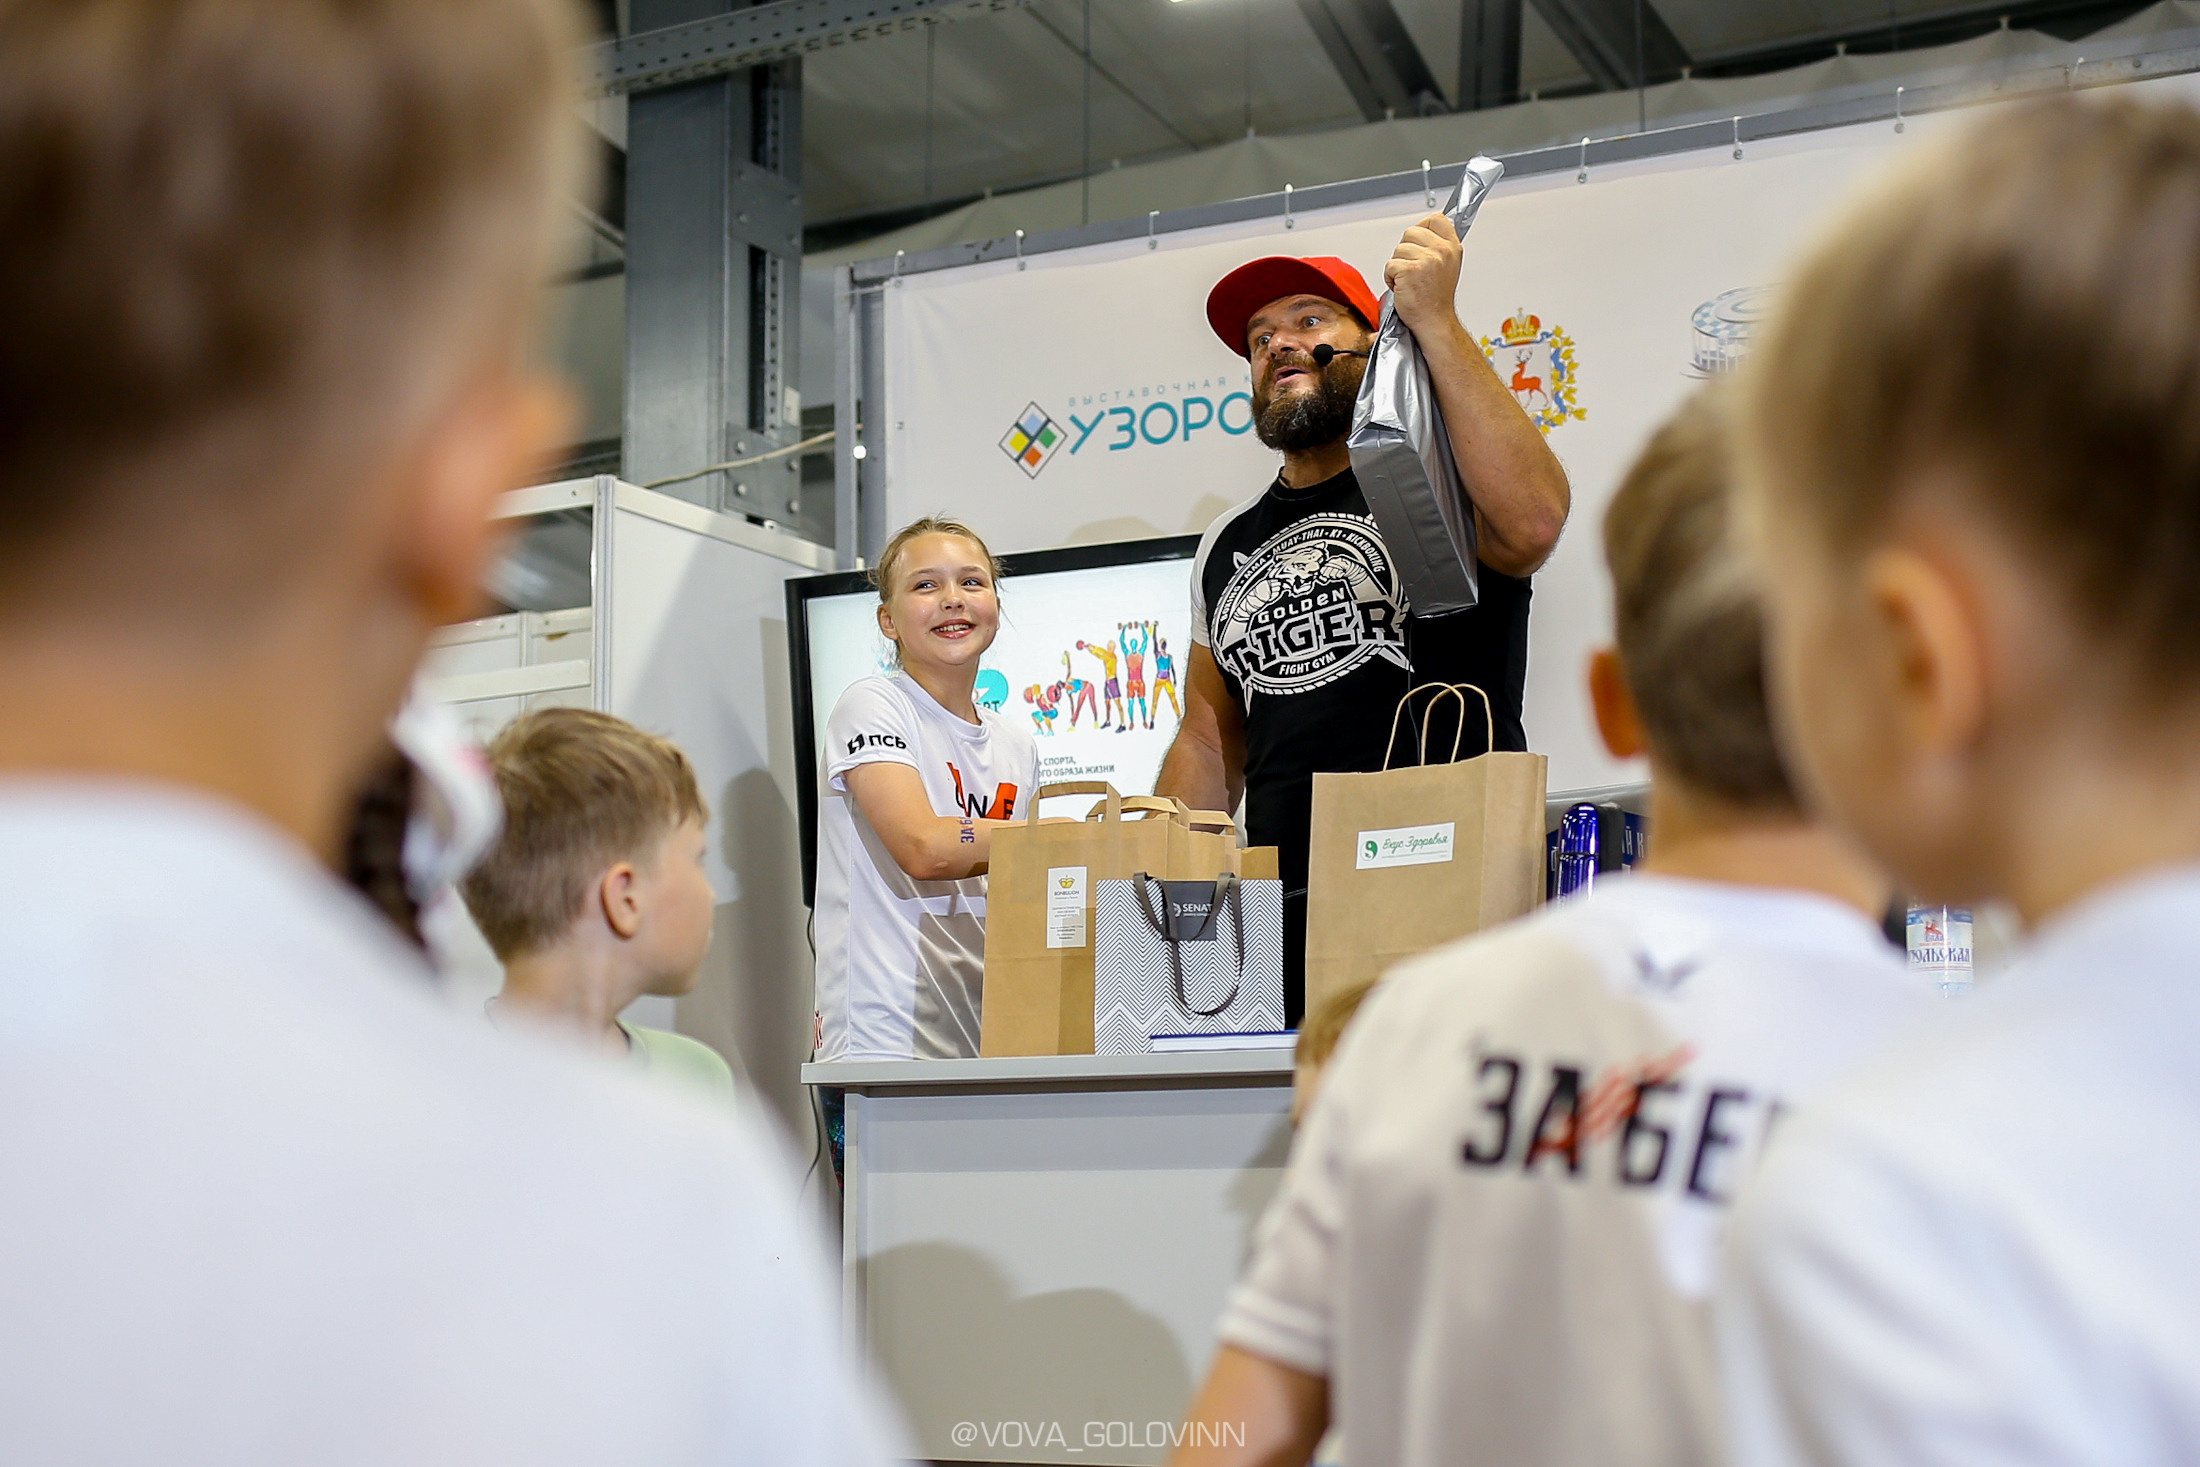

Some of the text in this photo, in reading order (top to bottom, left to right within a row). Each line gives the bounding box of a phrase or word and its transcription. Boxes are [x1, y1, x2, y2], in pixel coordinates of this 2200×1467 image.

[1068, 376, 1227, 407] ВЫСТАВОЧНАЯ
[1069, 391, 1252, 455] УЗОРО
[1244, 558, 1266, 580] MMA
[1272, 528, 1324, 555] MUAY-THAI
[1329, 528, 1343, 538] K1
[1345, 532, 1386, 573] KICKBOXING
[1220, 599, 1405, 684] TIGER
[1278, 651, 1337, 676] FIGHT GYM
[868, 734, 907, 750] ПСБ
[1043, 756, 1077, 767] СПОРТА,
[1053, 766, 1084, 777] ОБРАЗА
[1085, 764, 1115, 775] ЖИЗНИ
